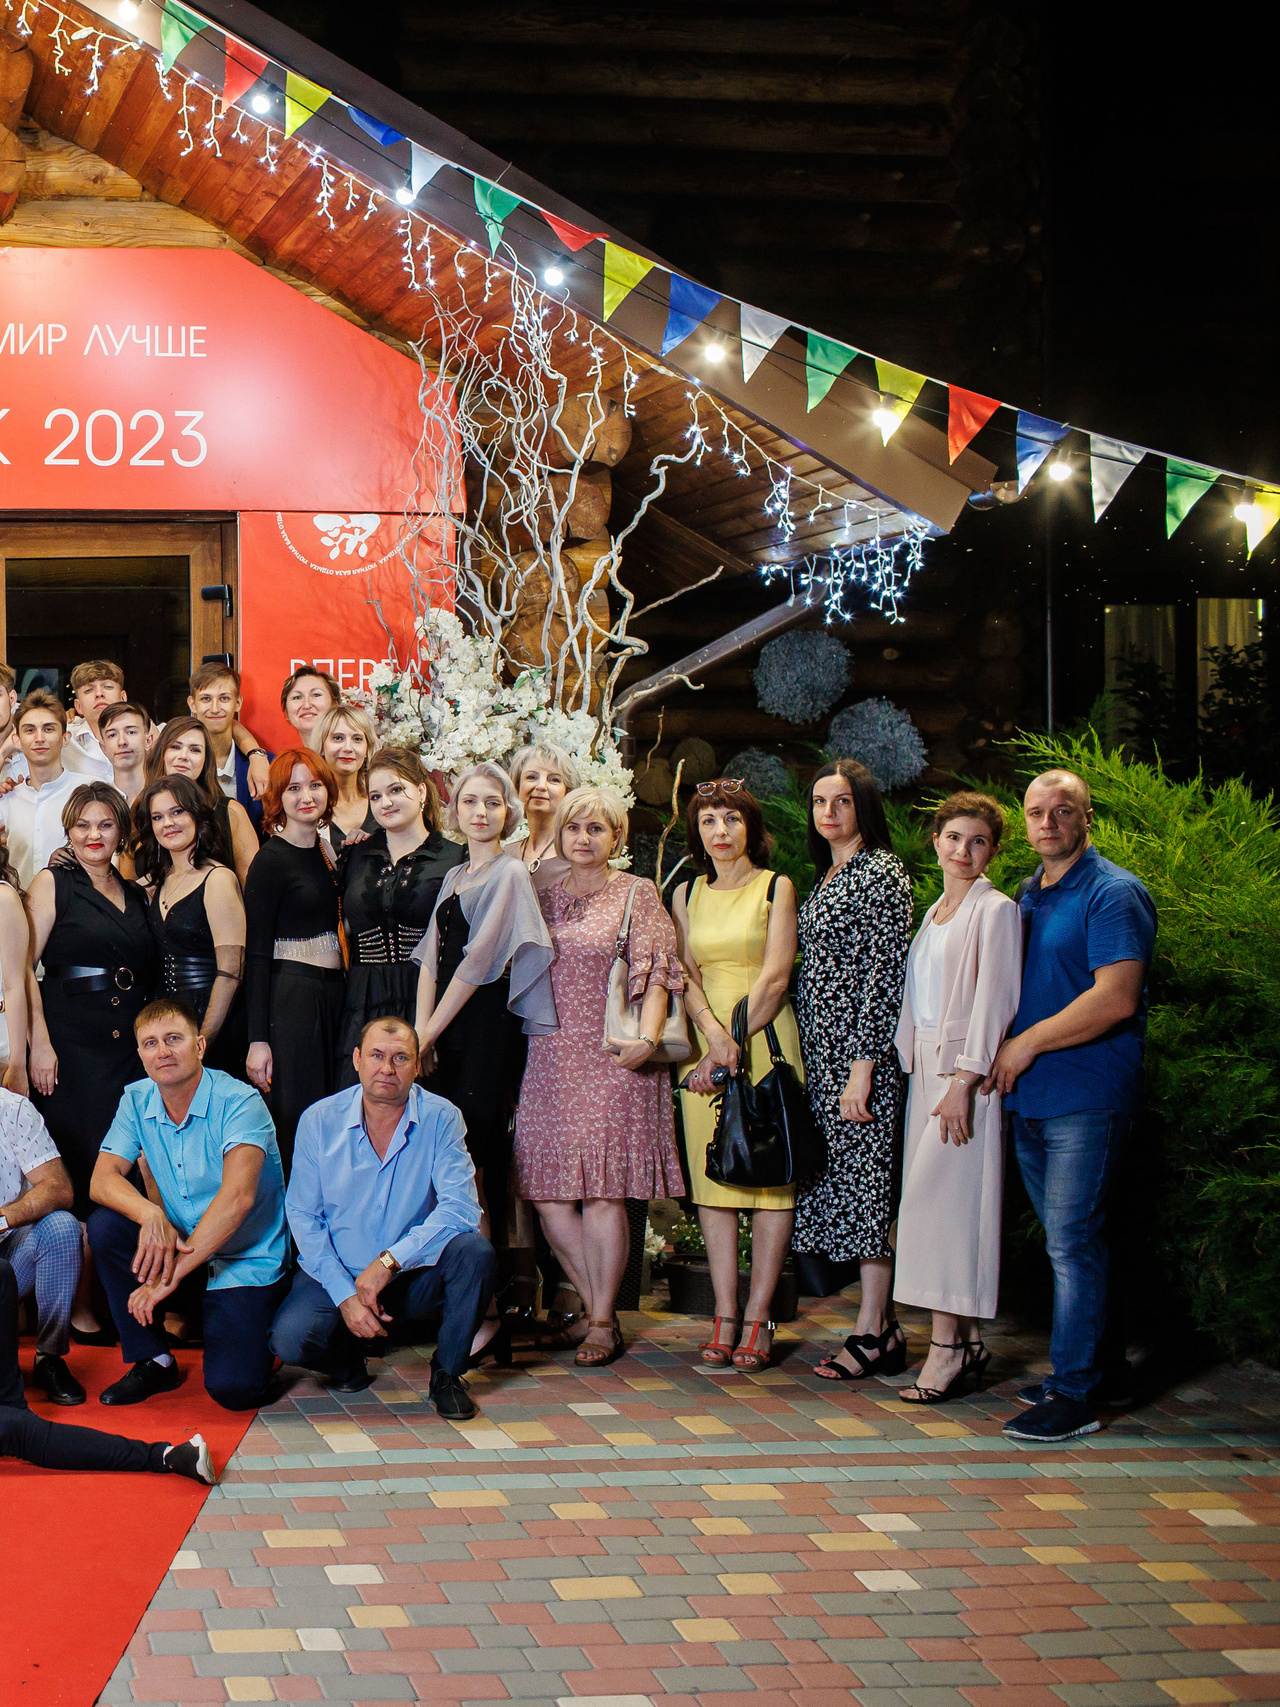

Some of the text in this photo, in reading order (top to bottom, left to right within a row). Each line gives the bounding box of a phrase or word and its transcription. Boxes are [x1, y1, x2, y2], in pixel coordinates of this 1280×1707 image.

[83, 324, 207, 357] ЛУЧШЕ
[44, 408, 208, 467] 2023
[280, 529, 291, 546] БАЗА
[288, 544, 309, 565] УЮТНАЯ
[310, 562, 335, 576] ОТДЫХА
[351, 562, 378, 575] УЮТНАЯ
